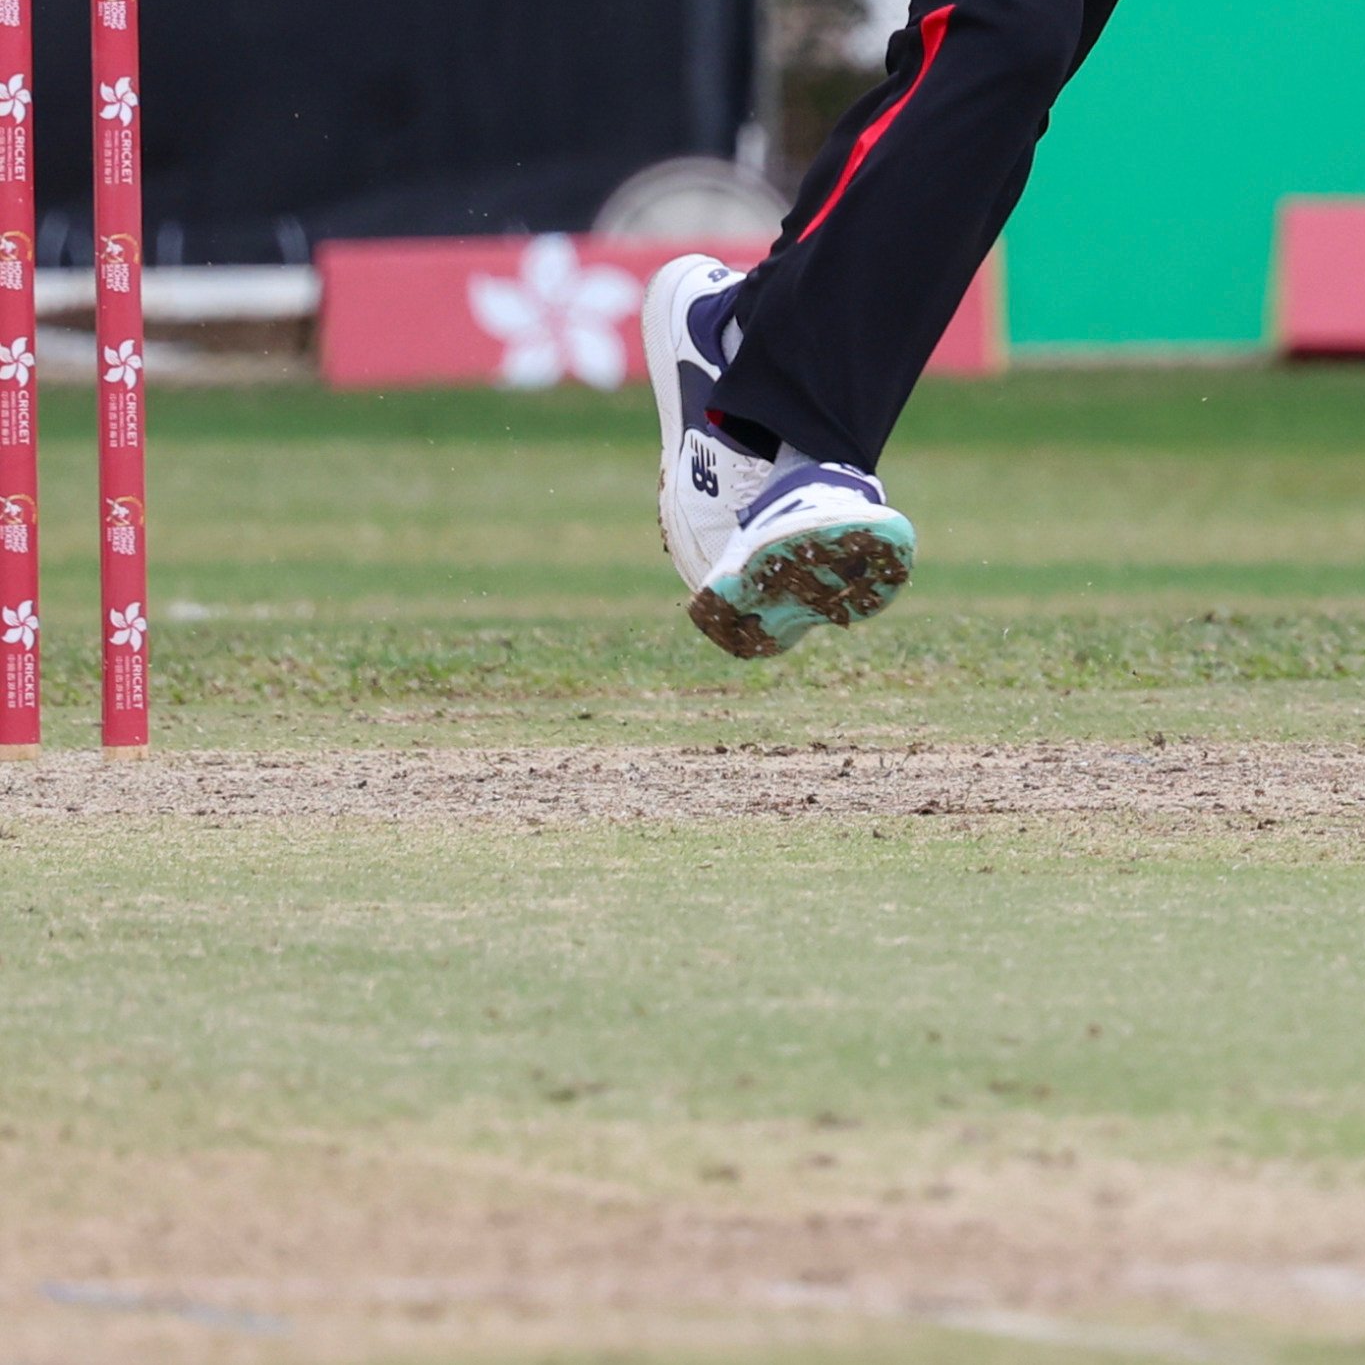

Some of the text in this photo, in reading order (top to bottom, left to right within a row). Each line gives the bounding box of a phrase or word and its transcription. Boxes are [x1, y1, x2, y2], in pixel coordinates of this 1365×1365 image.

[14, 126, 26, 182] CRICKET
[121, 129, 133, 185] CRICKET
[18, 389, 30, 445] CRICKET
[126, 392, 138, 448] CRICKET
[24, 652, 36, 708] CRICKET
[131, 654, 143, 710] CRICKET
